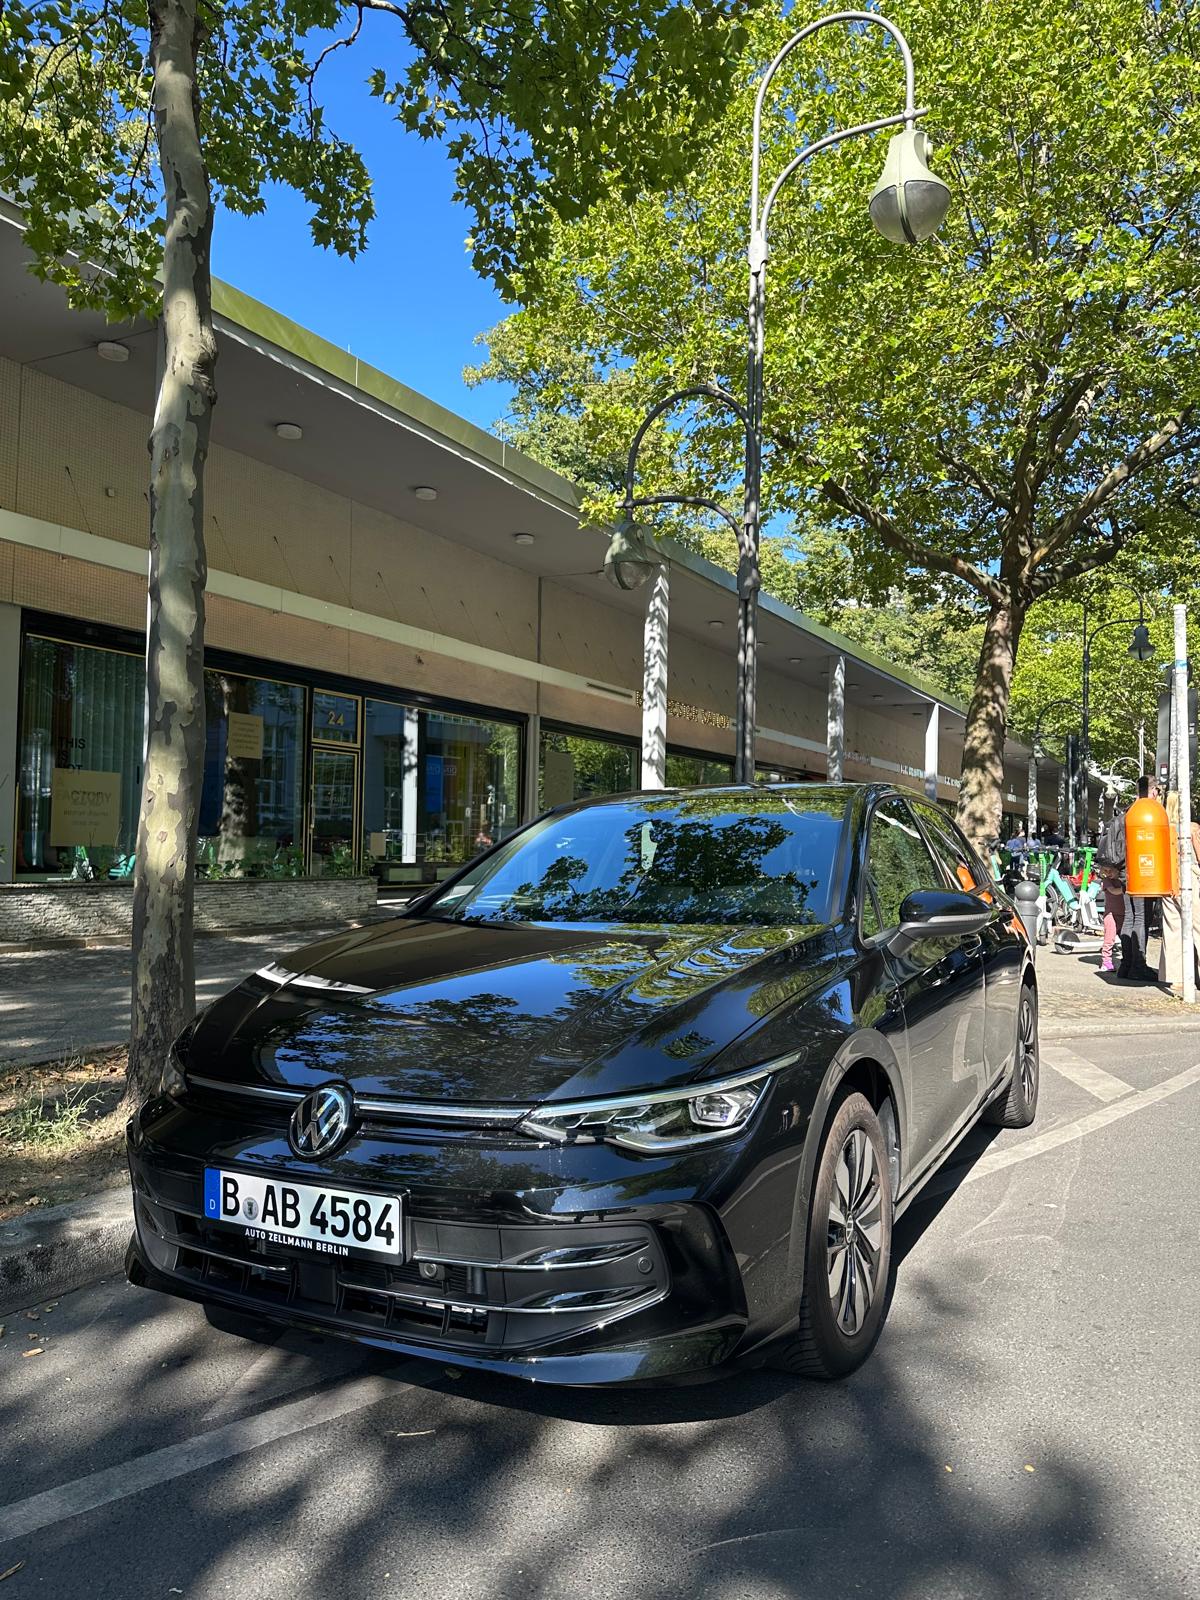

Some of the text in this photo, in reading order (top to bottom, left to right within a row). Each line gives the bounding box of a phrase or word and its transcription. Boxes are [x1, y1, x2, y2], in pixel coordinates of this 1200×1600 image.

[328, 710, 345, 726] 24
[209, 1198, 216, 1210] D
[222, 1176, 395, 1246] B AB 4584
[244, 1227, 349, 1256] AUTO ZELLMANN BERLIN
